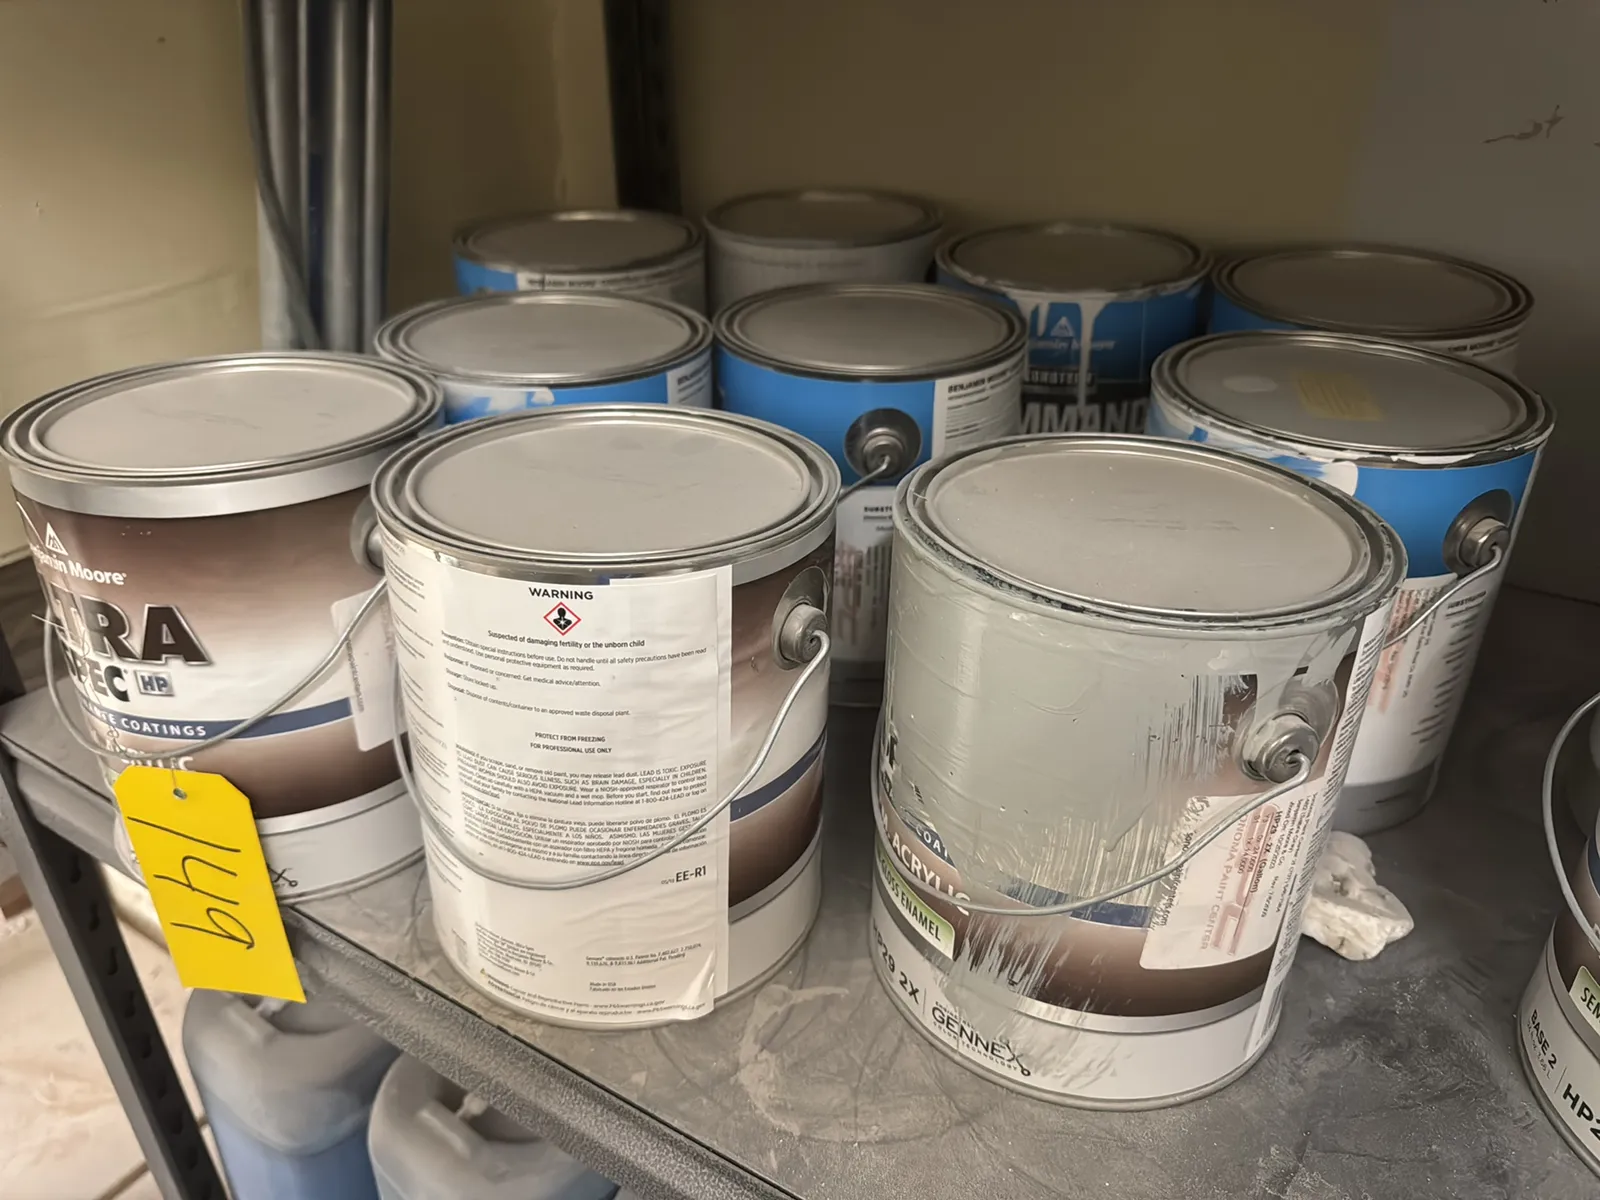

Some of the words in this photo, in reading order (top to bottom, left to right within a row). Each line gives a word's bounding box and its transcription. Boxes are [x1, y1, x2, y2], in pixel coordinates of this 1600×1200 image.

[68, 559, 125, 586] Moore
[528, 587, 594, 601] WARNING
[487, 630, 518, 642] Suspected
[526, 636, 558, 647] damaging
[559, 639, 583, 648] fertility
[604, 640, 629, 648] unborn
[629, 639, 645, 647] child
[506, 656, 531, 667] protective
[532, 660, 562, 670] equipment
[569, 664, 595, 672] required.
[526, 652, 544, 661] before
[544, 654, 556, 663] use.
[556, 655, 565, 663] Do
[575, 656, 595, 664] handle
[617, 656, 634, 664] safety
[635, 653, 667, 663] precautions
[667, 651, 680, 660] have
[681, 649, 694, 658] been
[695, 646, 707, 655] read
[140, 674, 169, 693] HP
[522, 674, 533, 682] Get
[533, 675, 554, 685] medical
[548, 707, 574, 716] approved
[574, 709, 591, 717] waste
[121, 717, 207, 737] COATINGS
[535, 730, 559, 741] PROTECT
[559, 733, 577, 742] FROM
[530, 741, 541, 750] FOR
[542, 742, 584, 754] PROFESSIONAL
[584, 746, 595, 754] USE
[596, 746, 613, 754] ONLY
[638, 774, 670, 784] ESPECIALLY
[640, 768, 655, 777] LEAD
[606, 792, 624, 800] Before
[1229, 813, 1248, 862] ONOMA
[126, 815, 255, 951] 149
[675, 865, 707, 884] EE-R1
[1215, 863, 1231, 901] PAINT
[1250, 858, 1267, 893] (Gallon)
[900, 888, 942, 943] ENAMEL
[1200, 904, 1220, 951] CENTER
[898, 970, 920, 1005] 2X
[931, 1005, 1031, 1076] GENNEX
[1530, 1008, 1551, 1056] BASE
[1547, 1053, 1558, 1070] 2
